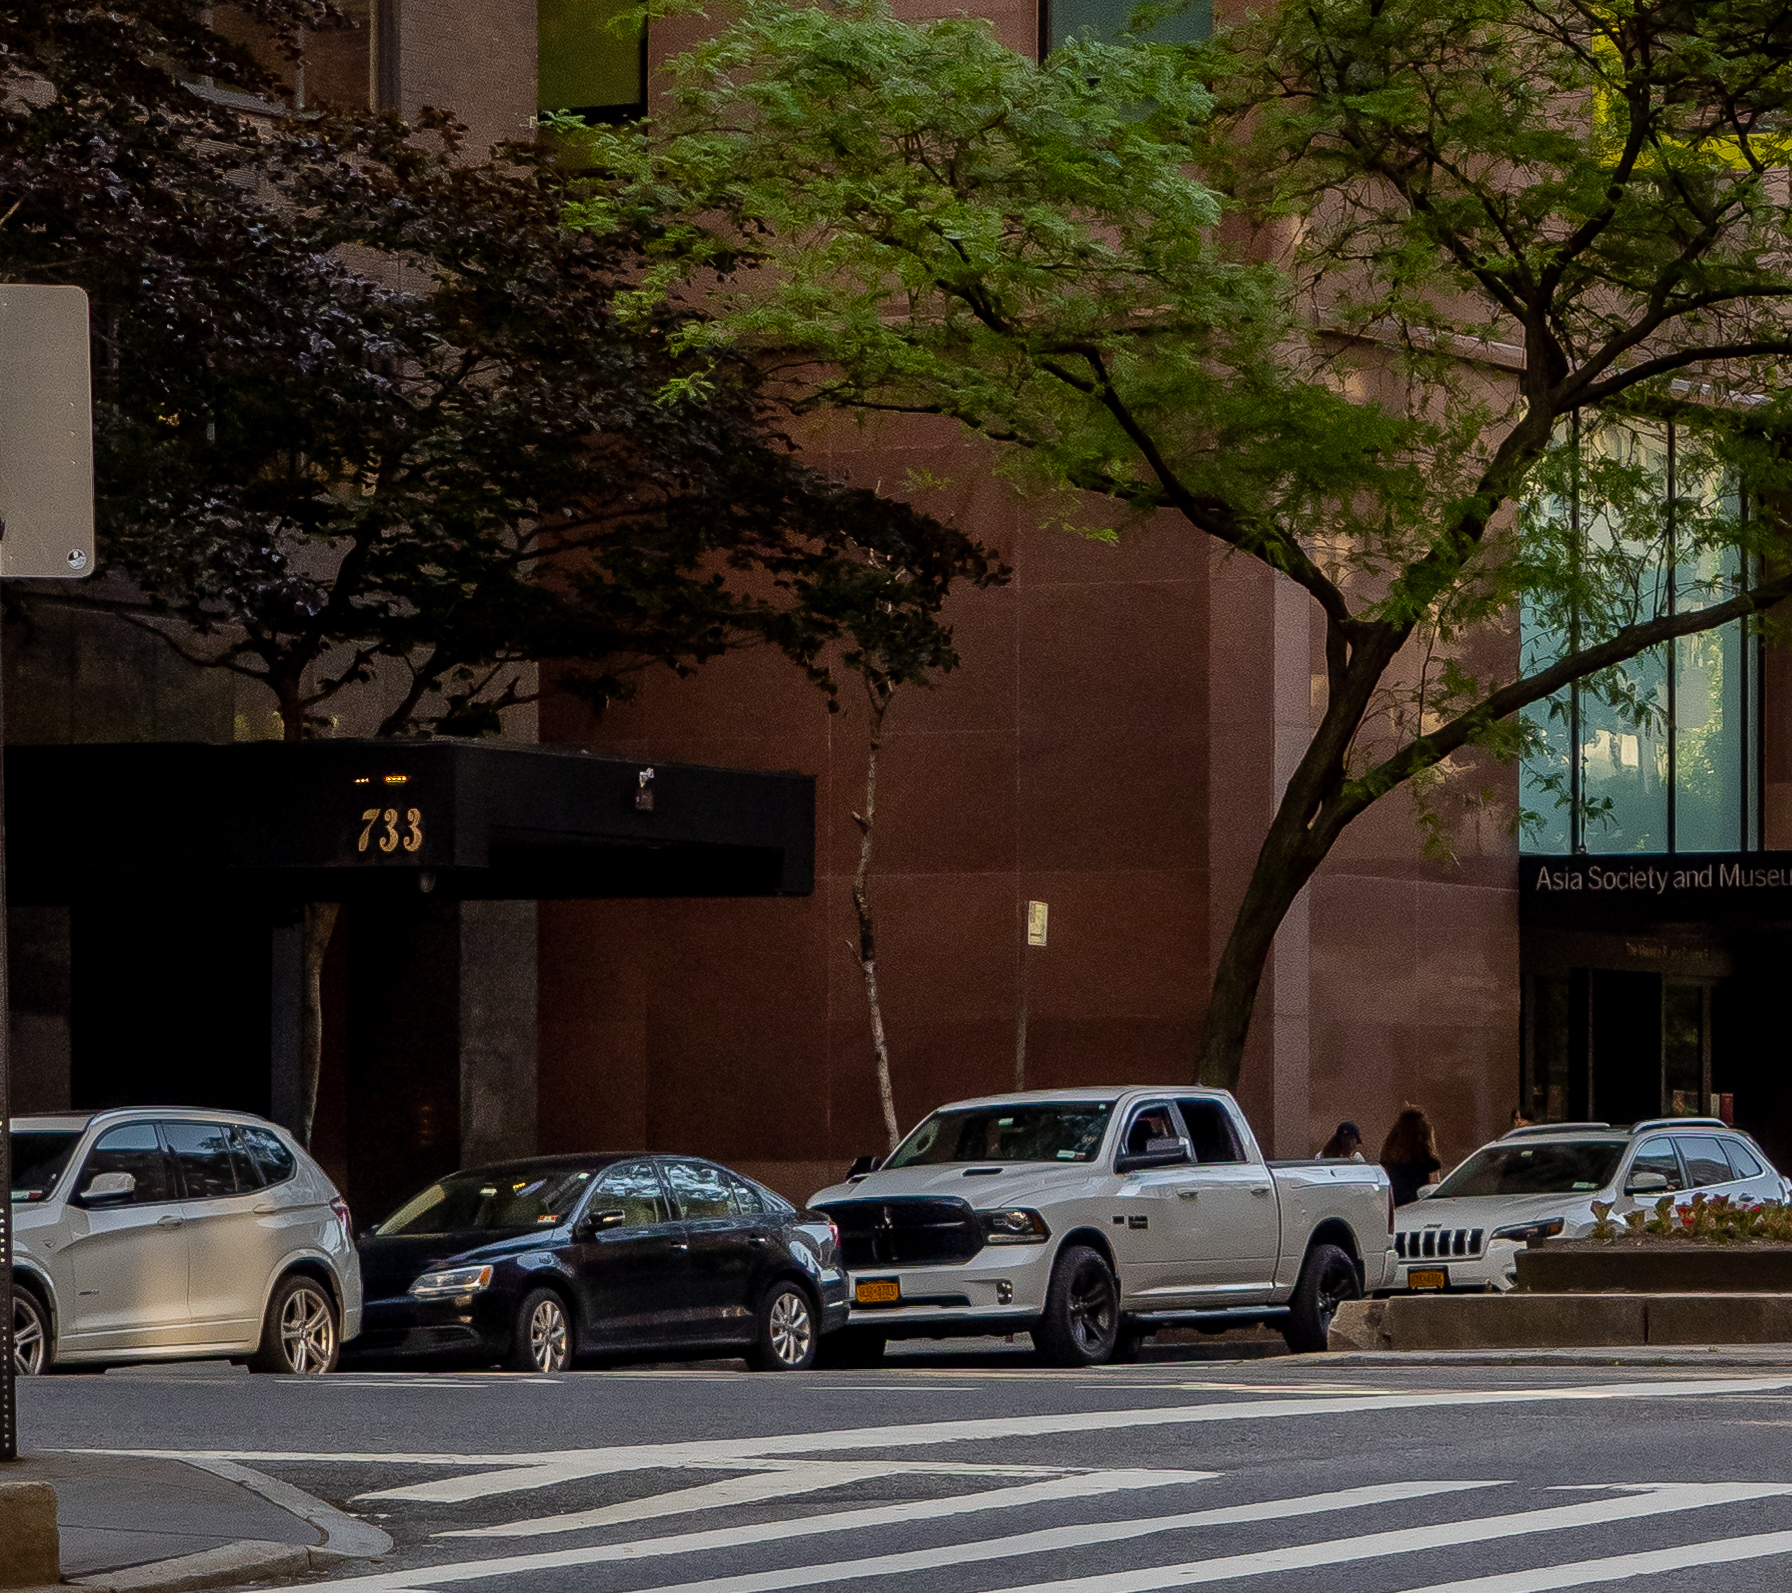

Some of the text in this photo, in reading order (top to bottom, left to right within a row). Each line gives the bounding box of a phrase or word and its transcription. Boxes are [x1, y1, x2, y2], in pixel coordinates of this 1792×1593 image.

[358, 808, 423, 852] 733
[1535, 866, 1583, 891] Asia
[1587, 865, 1669, 895] Society
[1673, 864, 1713, 889] and
